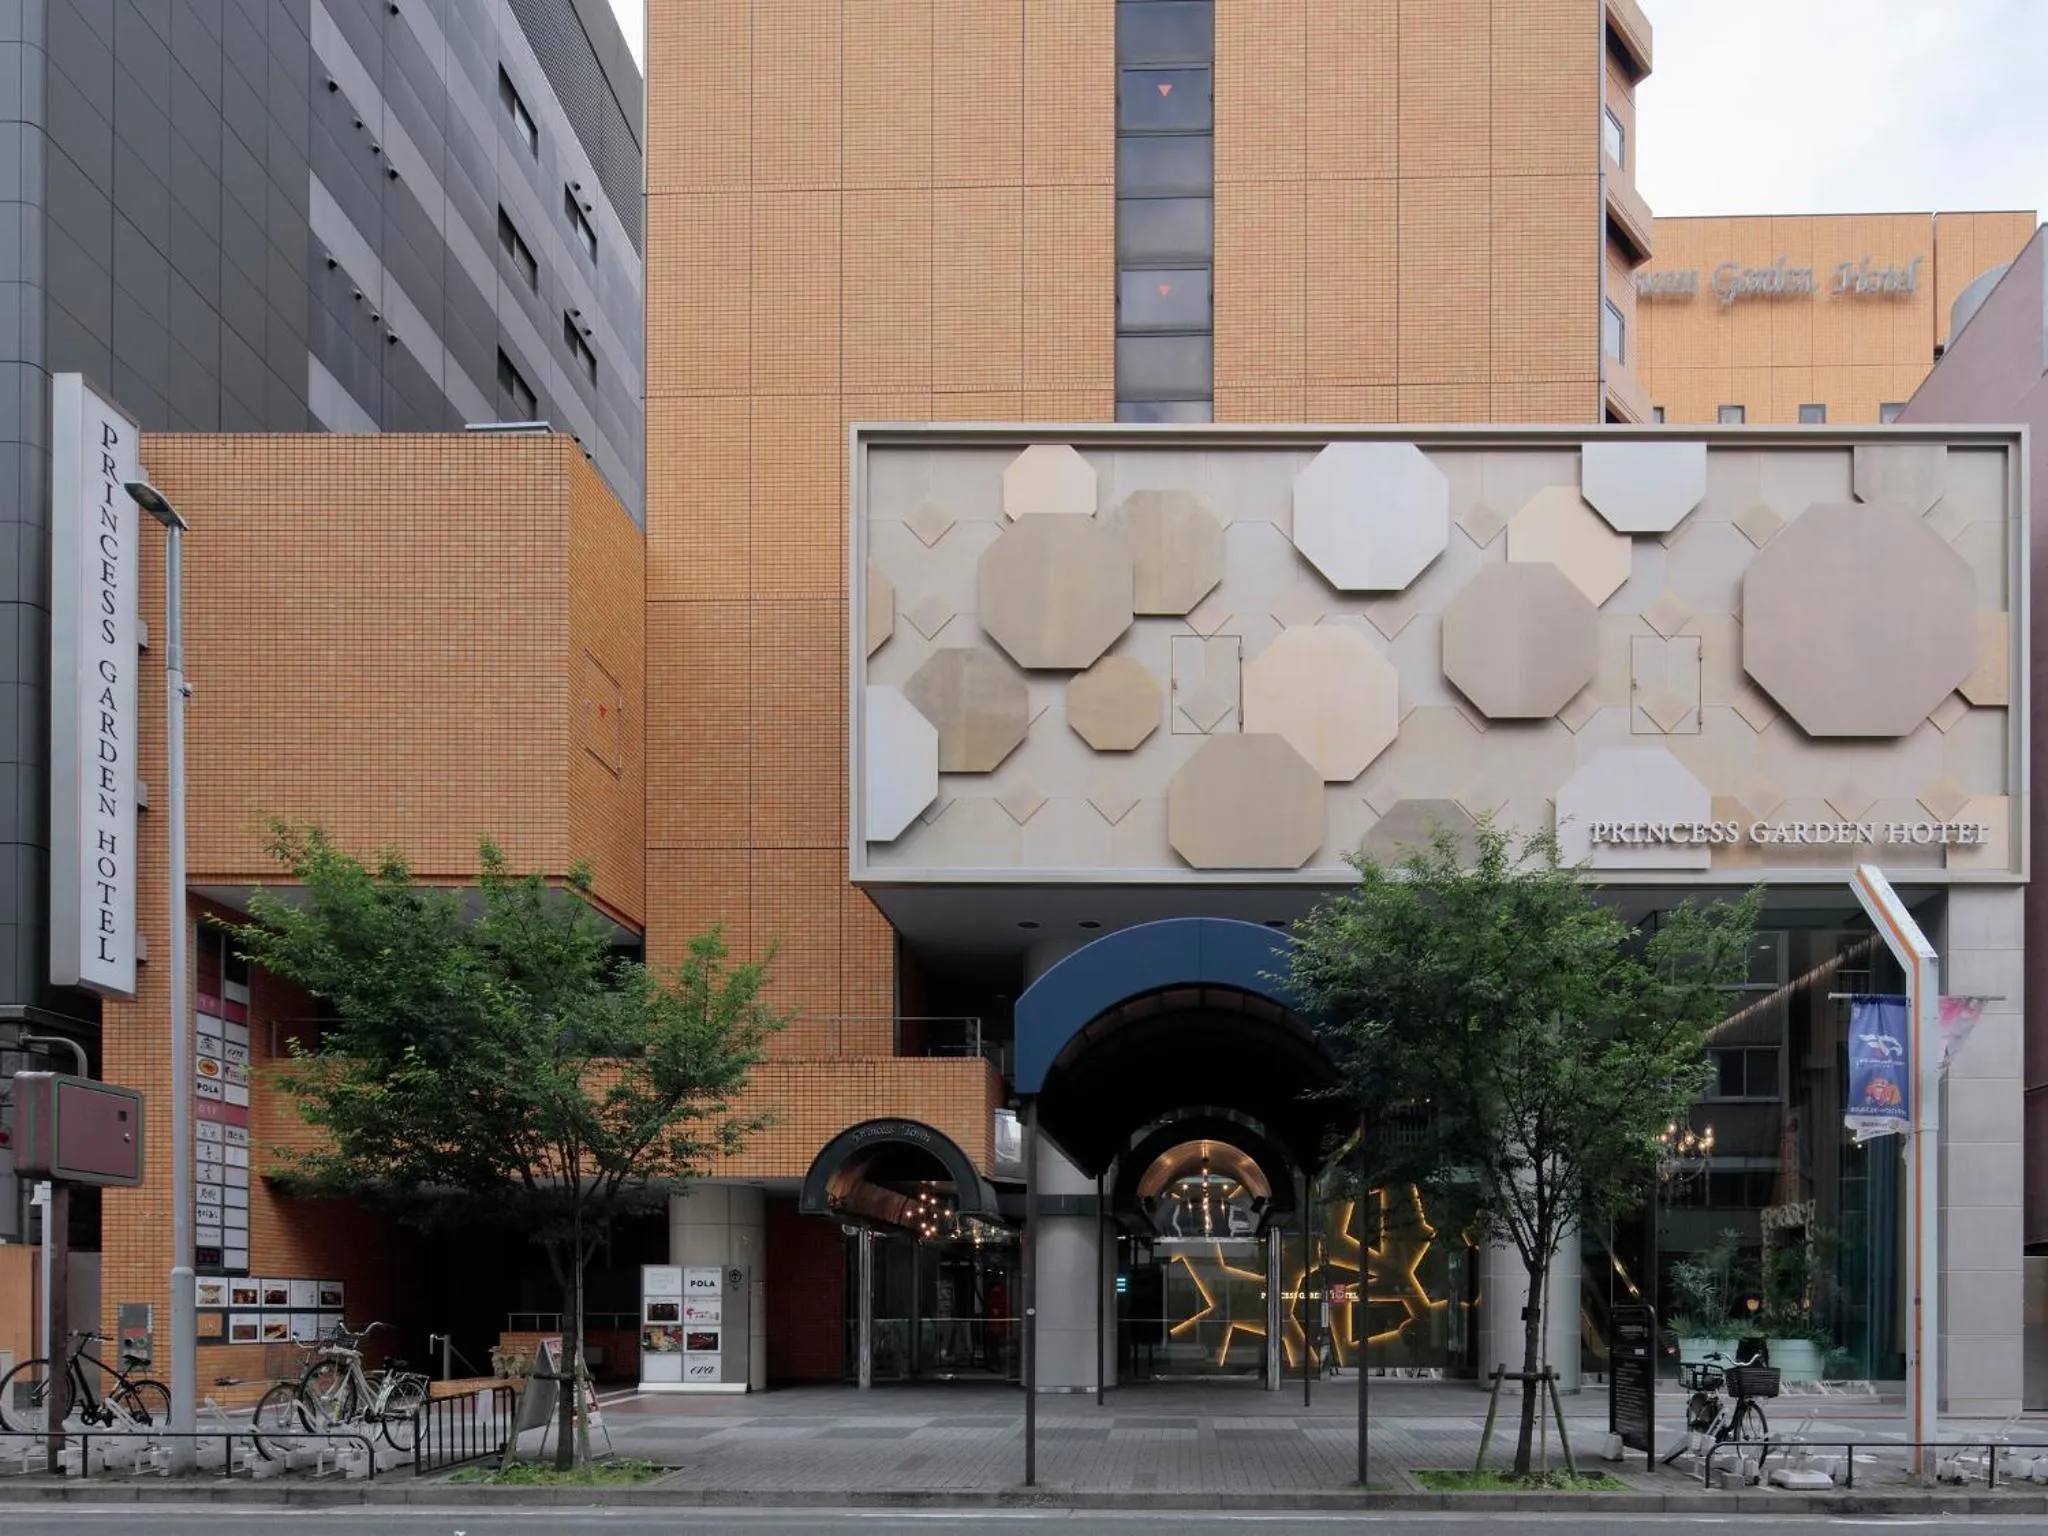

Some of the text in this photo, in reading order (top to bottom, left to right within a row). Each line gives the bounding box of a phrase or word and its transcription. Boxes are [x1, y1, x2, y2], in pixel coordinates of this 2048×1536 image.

[1711, 256, 1818, 306] Garden
[97, 420, 119, 963] PRINCESS GARDEN HOTEL
[1591, 820, 1988, 846] PRINCESS GARDEN HOTEL
[197, 1081, 219, 1095] POLA
[690, 1280, 716, 1288] POLA
